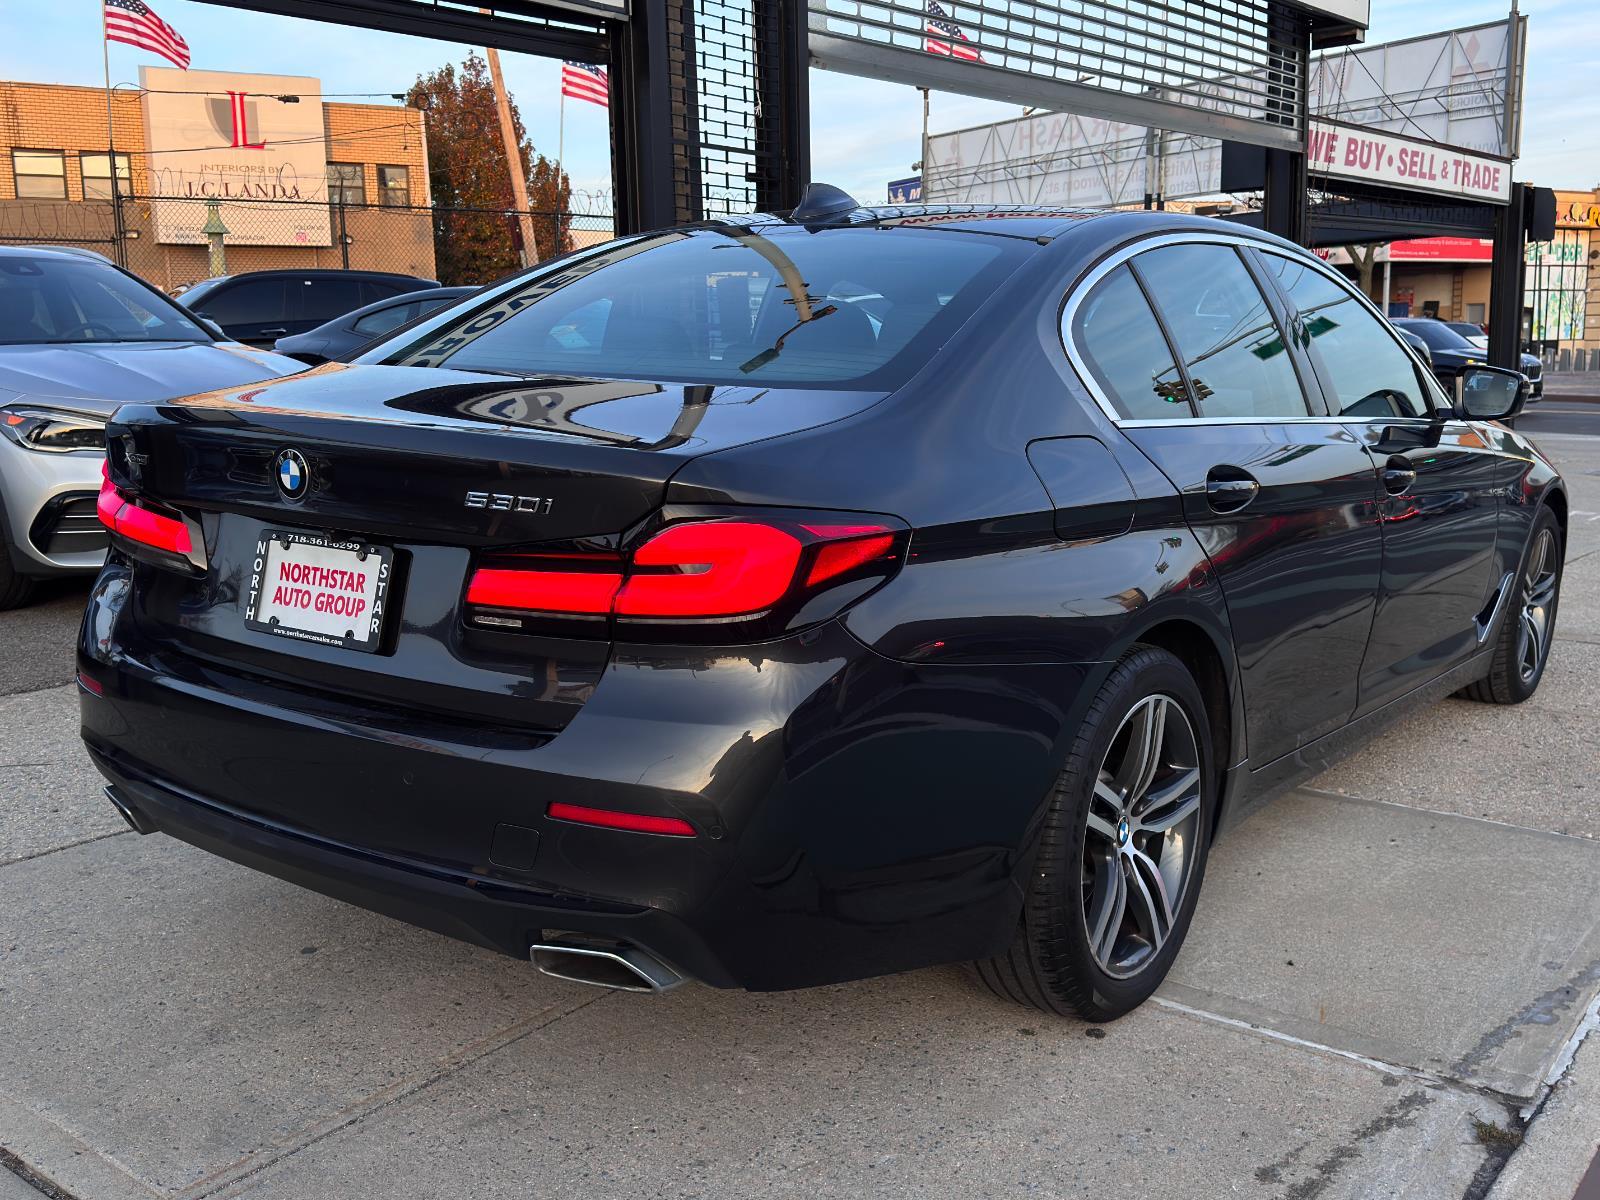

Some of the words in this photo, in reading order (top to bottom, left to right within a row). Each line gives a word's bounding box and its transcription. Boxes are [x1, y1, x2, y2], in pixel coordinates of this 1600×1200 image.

[201, 164, 265, 173] INTERIORS
[1308, 128, 1339, 164] WE
[1344, 136, 1386, 171] BUY
[1397, 147, 1437, 181] SELL
[1441, 160, 1449, 179] &
[1453, 159, 1500, 192] TRADE
[464, 491, 553, 514] 530i
[245, 540, 267, 621] NORTH
[279, 561, 366, 594] NORTHSTAR
[272, 586, 312, 609] AUTO
[314, 592, 366, 618] GROUP
[369, 563, 389, 634] STAR
